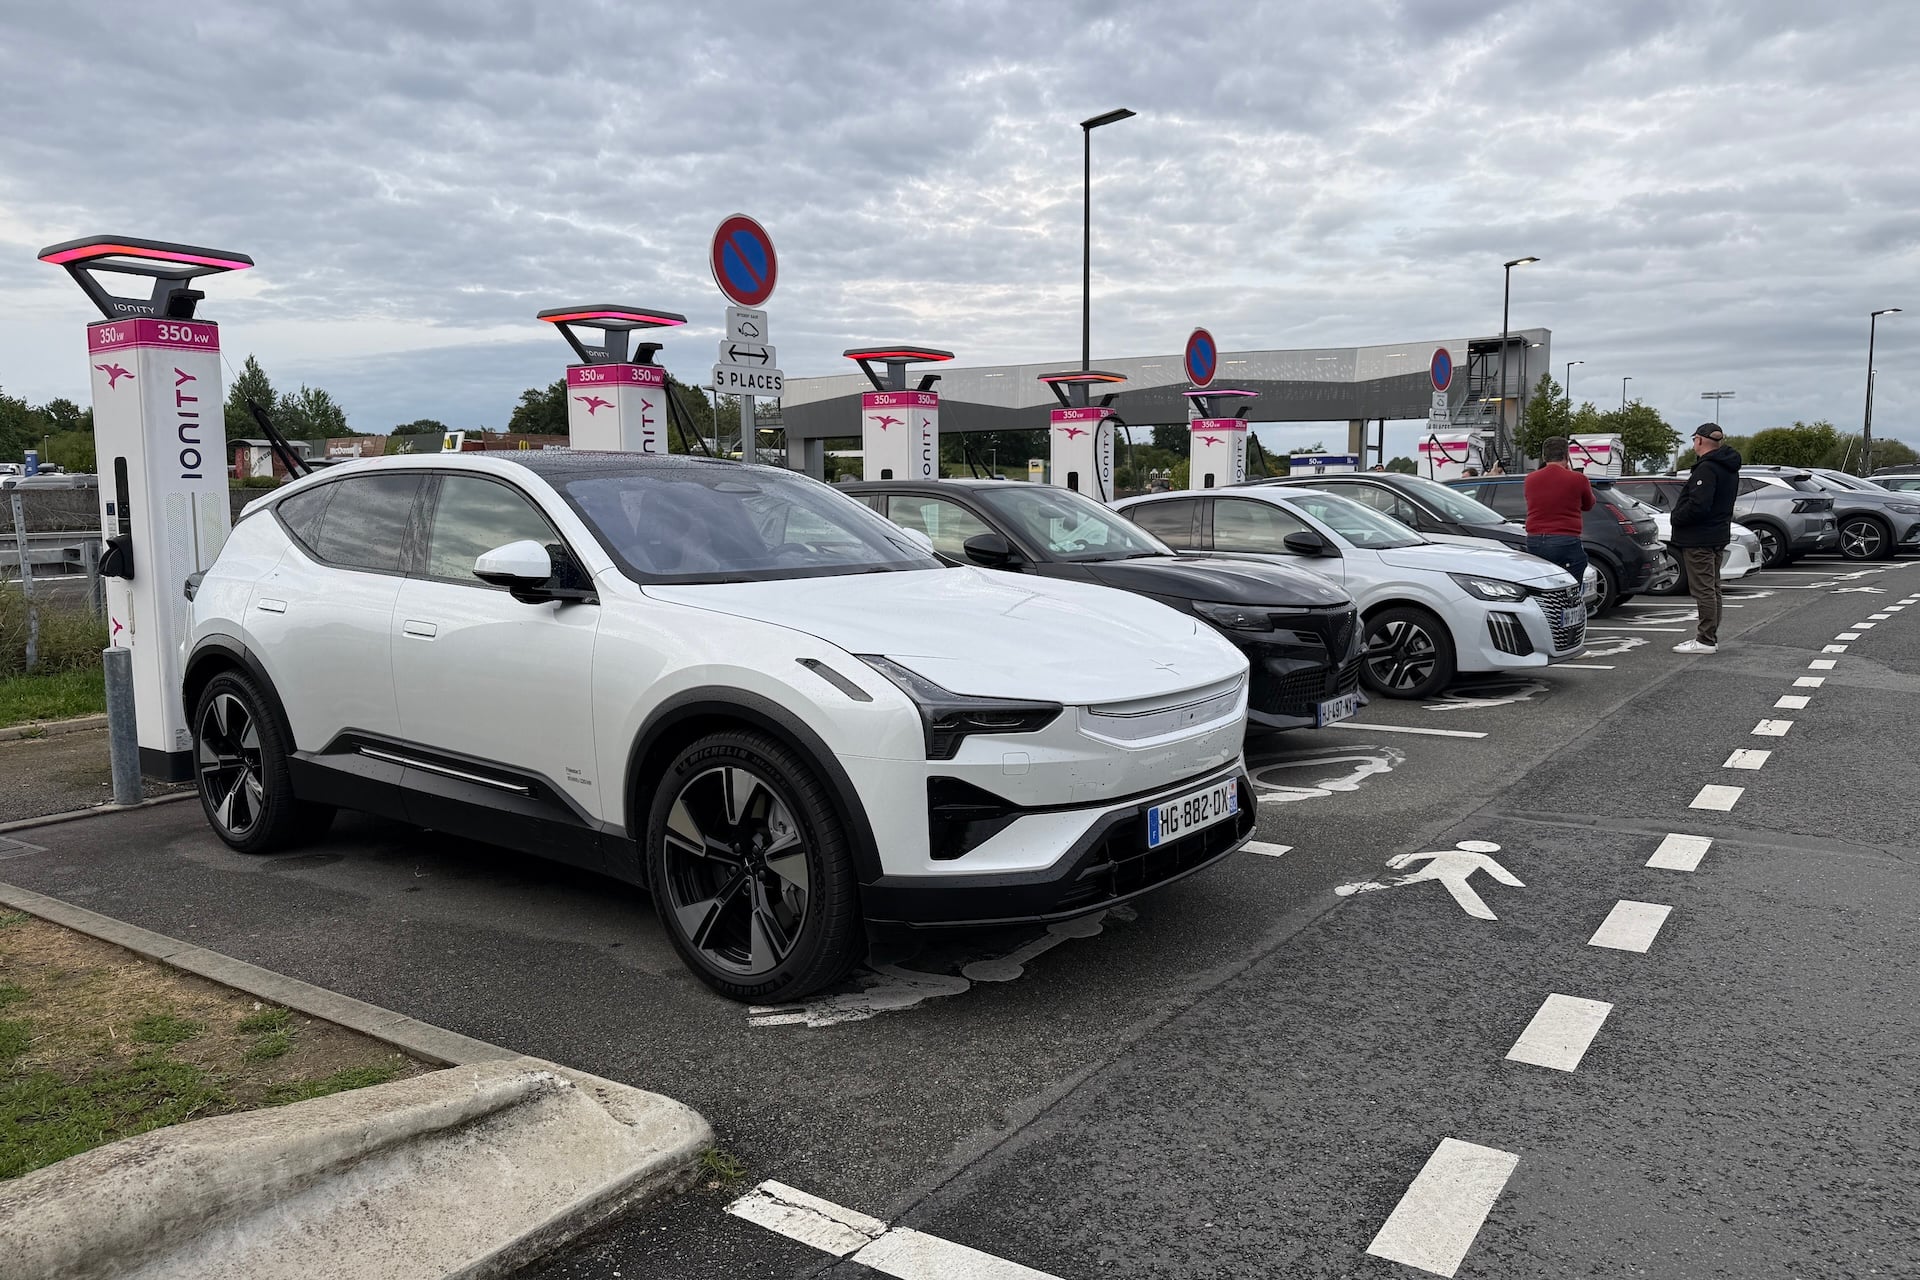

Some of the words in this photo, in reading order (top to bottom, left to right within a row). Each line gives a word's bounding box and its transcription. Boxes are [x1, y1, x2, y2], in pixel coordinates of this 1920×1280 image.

[113, 303, 155, 314] IONITY
[100, 327, 117, 344] 350
[157, 324, 193, 342] 350
[194, 334, 209, 343] kW
[579, 369, 597, 382] 350
[631, 368, 651, 381] 350
[716, 371, 725, 385] 5
[730, 371, 782, 390] PLACES
[874, 395, 890, 405] 350
[917, 394, 931, 405] 350
[174, 367, 203, 479] IONITY
[1063, 410, 1077, 419] 350
[641, 398, 656, 453] NITY
[689, 746, 749, 763] MICHELIN
[1160, 786, 1229, 837] HG-882-DX
